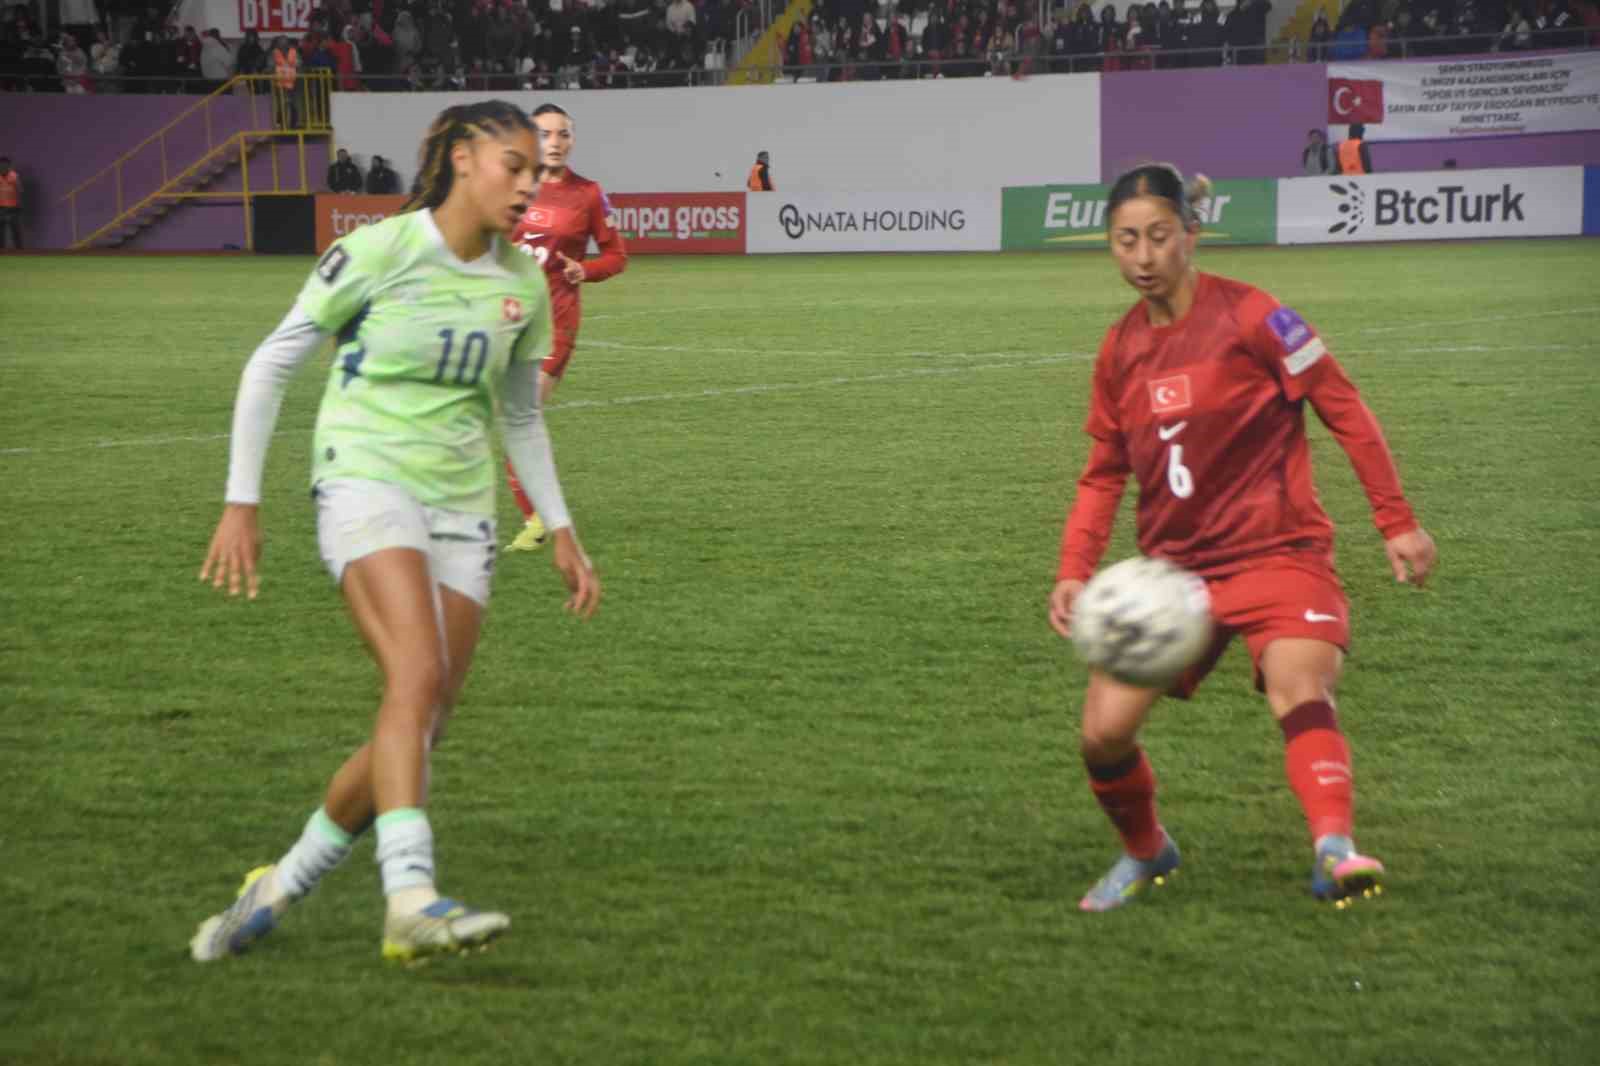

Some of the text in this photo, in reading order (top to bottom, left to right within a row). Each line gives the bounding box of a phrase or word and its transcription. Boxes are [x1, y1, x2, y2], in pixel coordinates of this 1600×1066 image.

[675, 206, 740, 239] gross
[806, 209, 966, 231] NATA HOLDING
[1044, 192, 1232, 228] Eurar
[1375, 184, 1525, 226] BtcTurk
[433, 328, 489, 385] 10
[1167, 444, 1195, 498] 6
